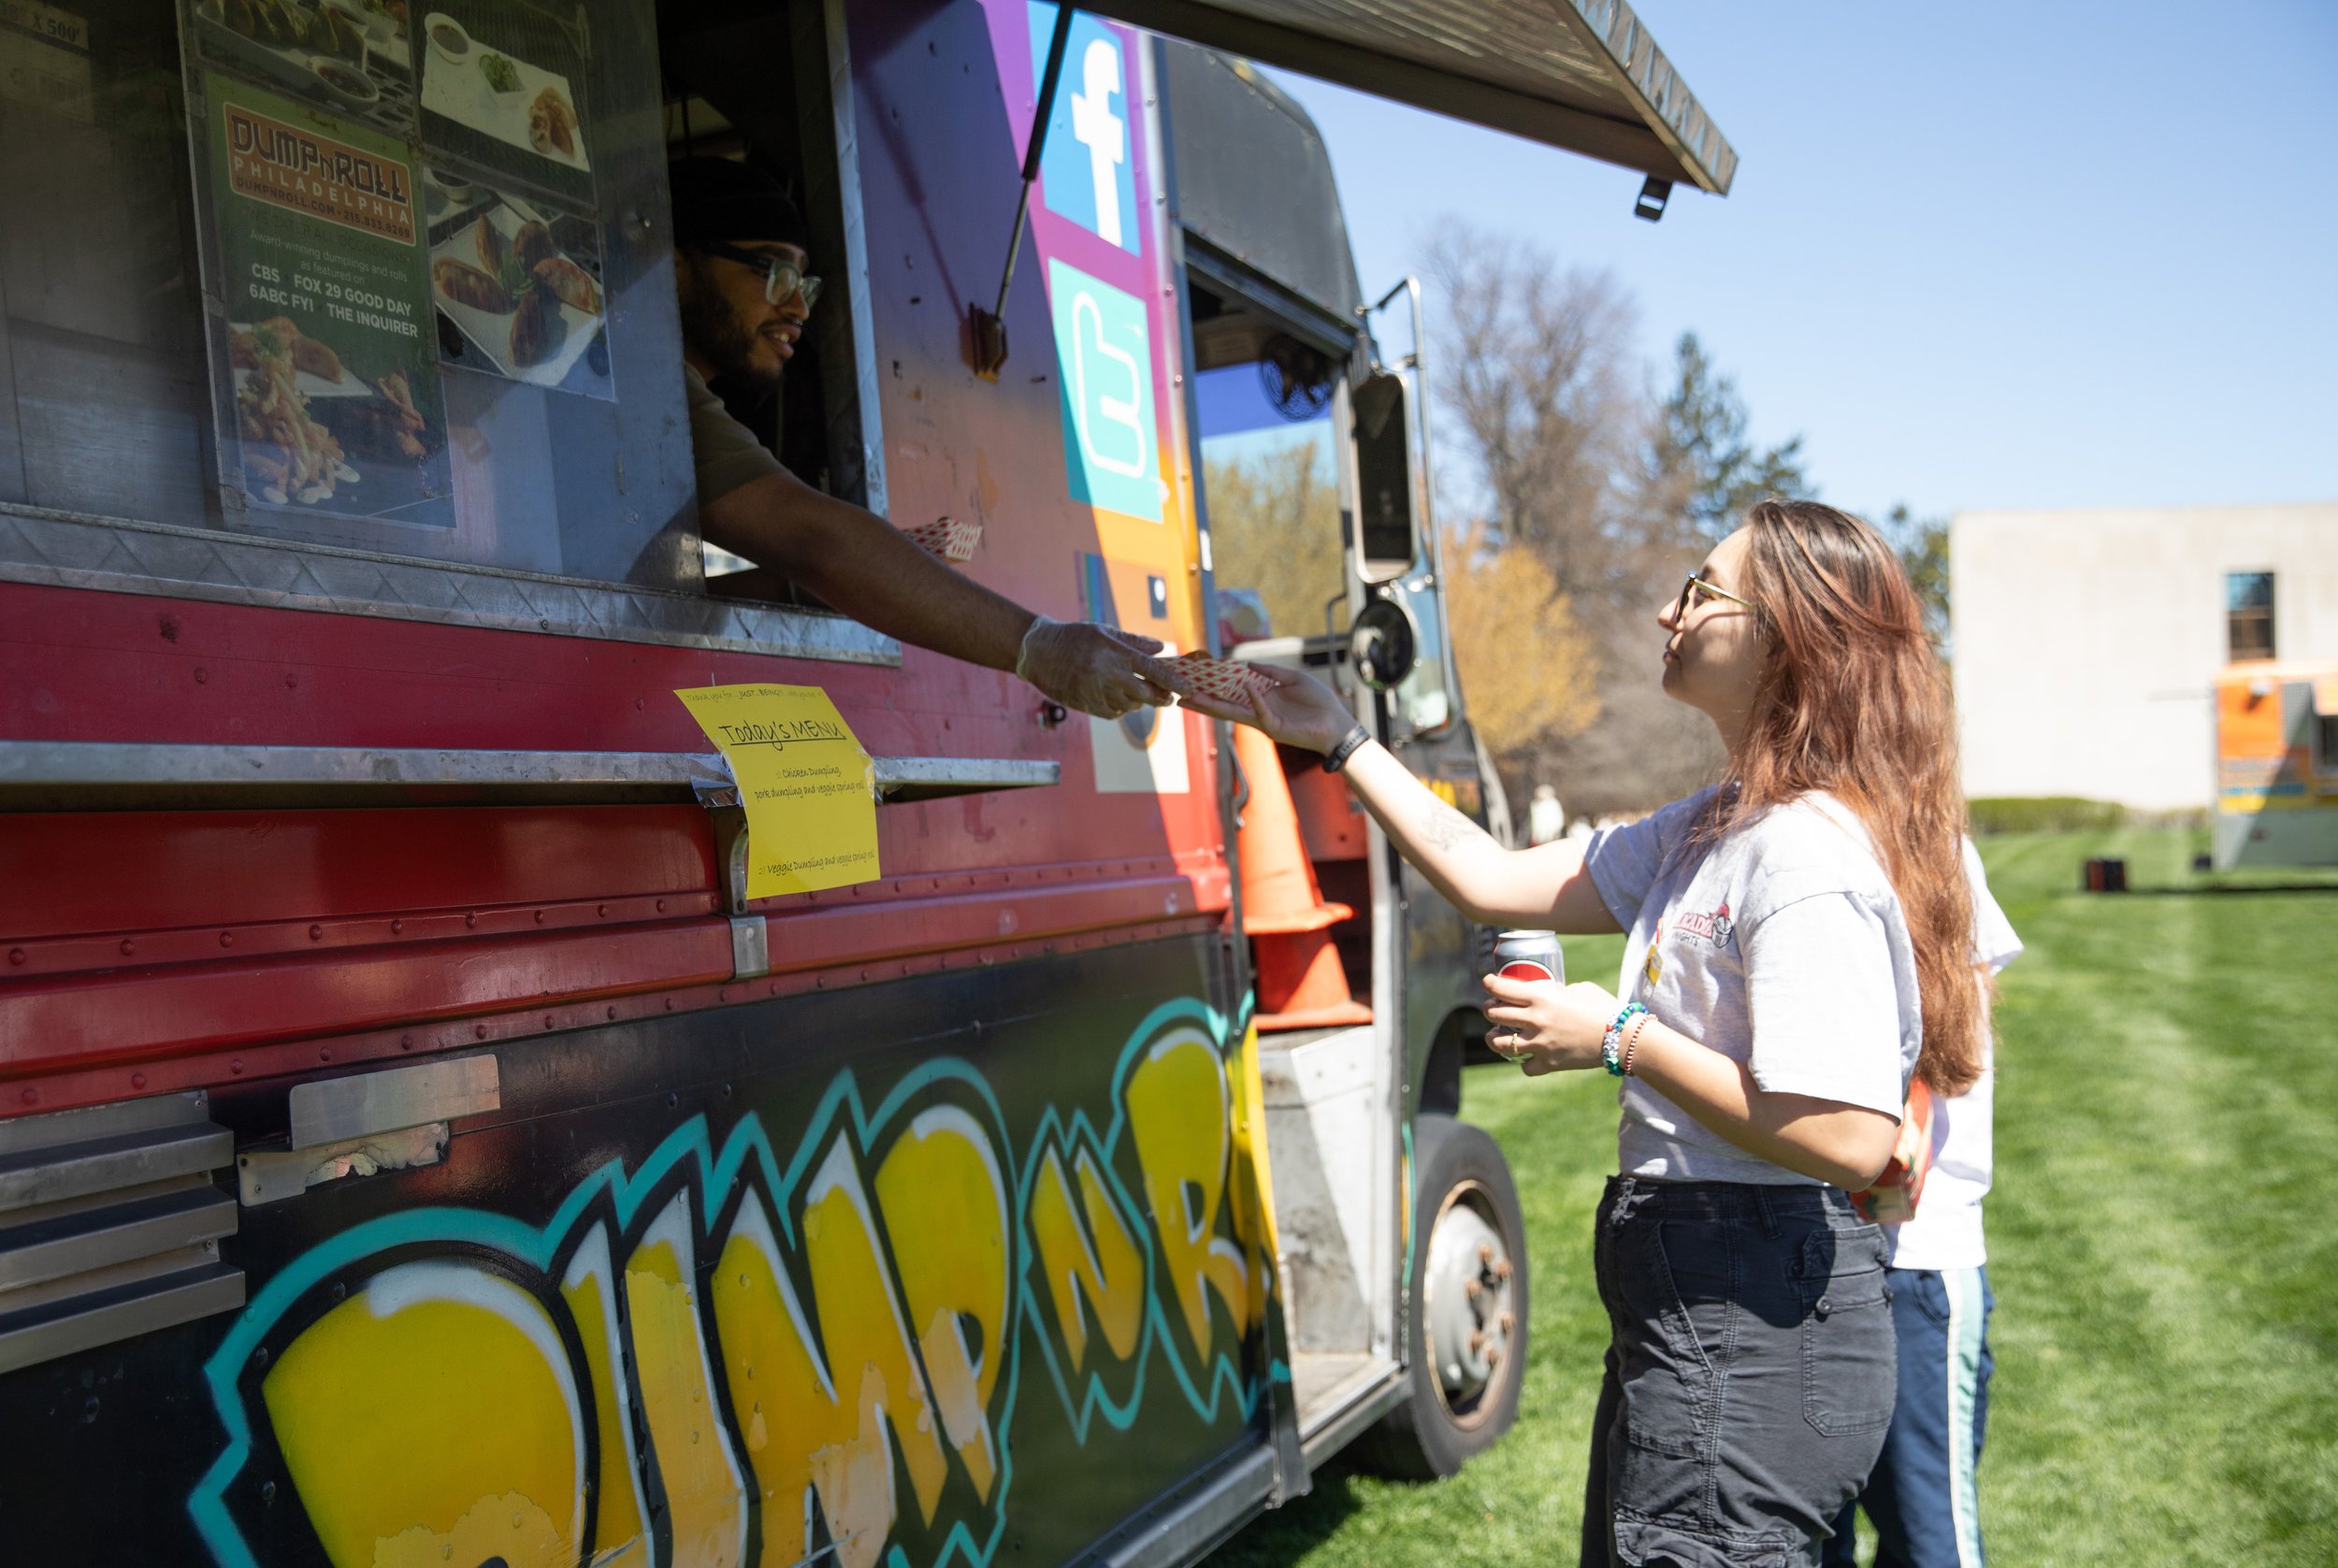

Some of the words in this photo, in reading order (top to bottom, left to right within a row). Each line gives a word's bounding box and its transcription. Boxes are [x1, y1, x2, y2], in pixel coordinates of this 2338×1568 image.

[234, 157, 409, 224] PHILADELPHIA
[237, 178, 335, 216] DUMPNROLL.COM
[250, 230, 321, 260] Award-winning
[323, 252, 369, 273] dumplings
[371, 265, 388, 278] and
[390, 268, 408, 282] rolls
[339, 235, 406, 263] OCCASIONS
[252, 263, 280, 283] CBS
[294, 274, 322, 295] FOX
[325, 282, 341, 298] 29
[344, 287, 383, 309] GOOD
[387, 298, 411, 316] DAY
[301, 261, 311, 270] as
[313, 264, 352, 281] featured
[353, 276, 365, 285] on
[249, 283, 288, 306] 6ABC
[292, 294, 314, 312] FYI
[326, 303, 354, 323] THE
[356, 309, 418, 338] INQUIRER
[718, 719, 790, 751] Today's
[790, 720, 844, 740] MENU
[782, 768, 807, 778] Chicken
[754, 789, 771, 803] pork
[772, 785, 803, 800] dumpling
[804, 785, 815, 794] and
[816, 782, 836, 797] veggie
[836, 781, 855, 795] spring
